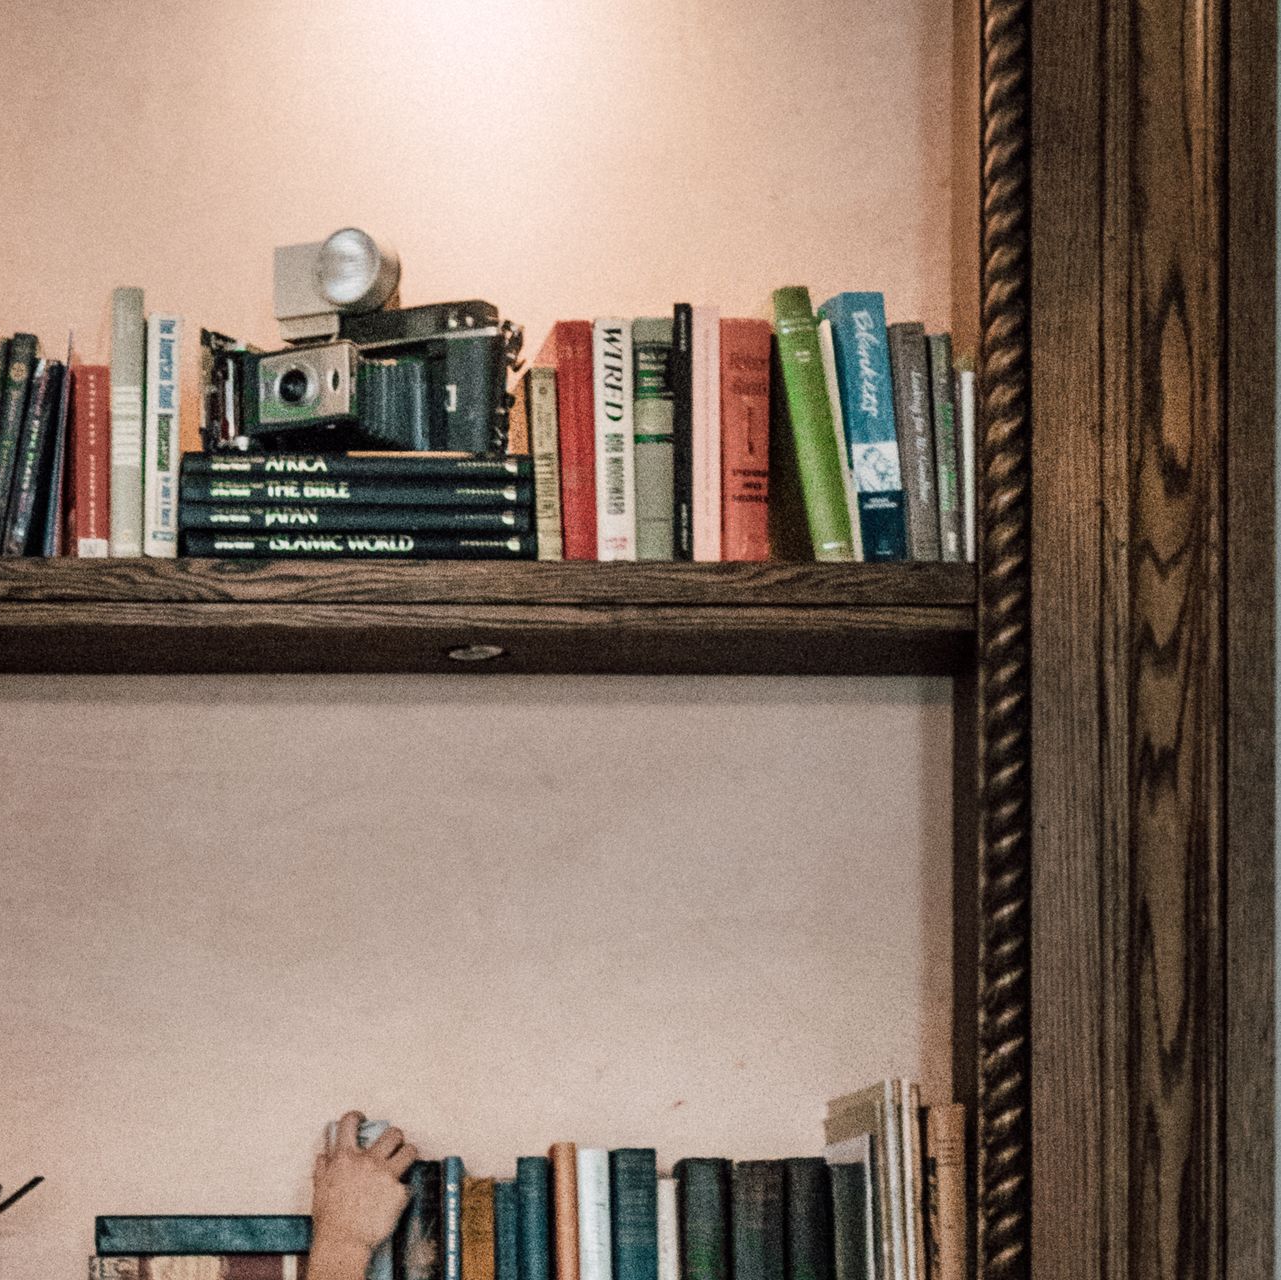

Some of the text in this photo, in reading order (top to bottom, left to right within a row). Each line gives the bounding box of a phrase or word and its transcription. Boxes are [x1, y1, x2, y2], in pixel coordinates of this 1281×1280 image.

[602, 326, 624, 422] WIRED
[851, 310, 880, 418] Blankets
[265, 456, 327, 472] AFRICA
[347, 535, 415, 551] WORLD
